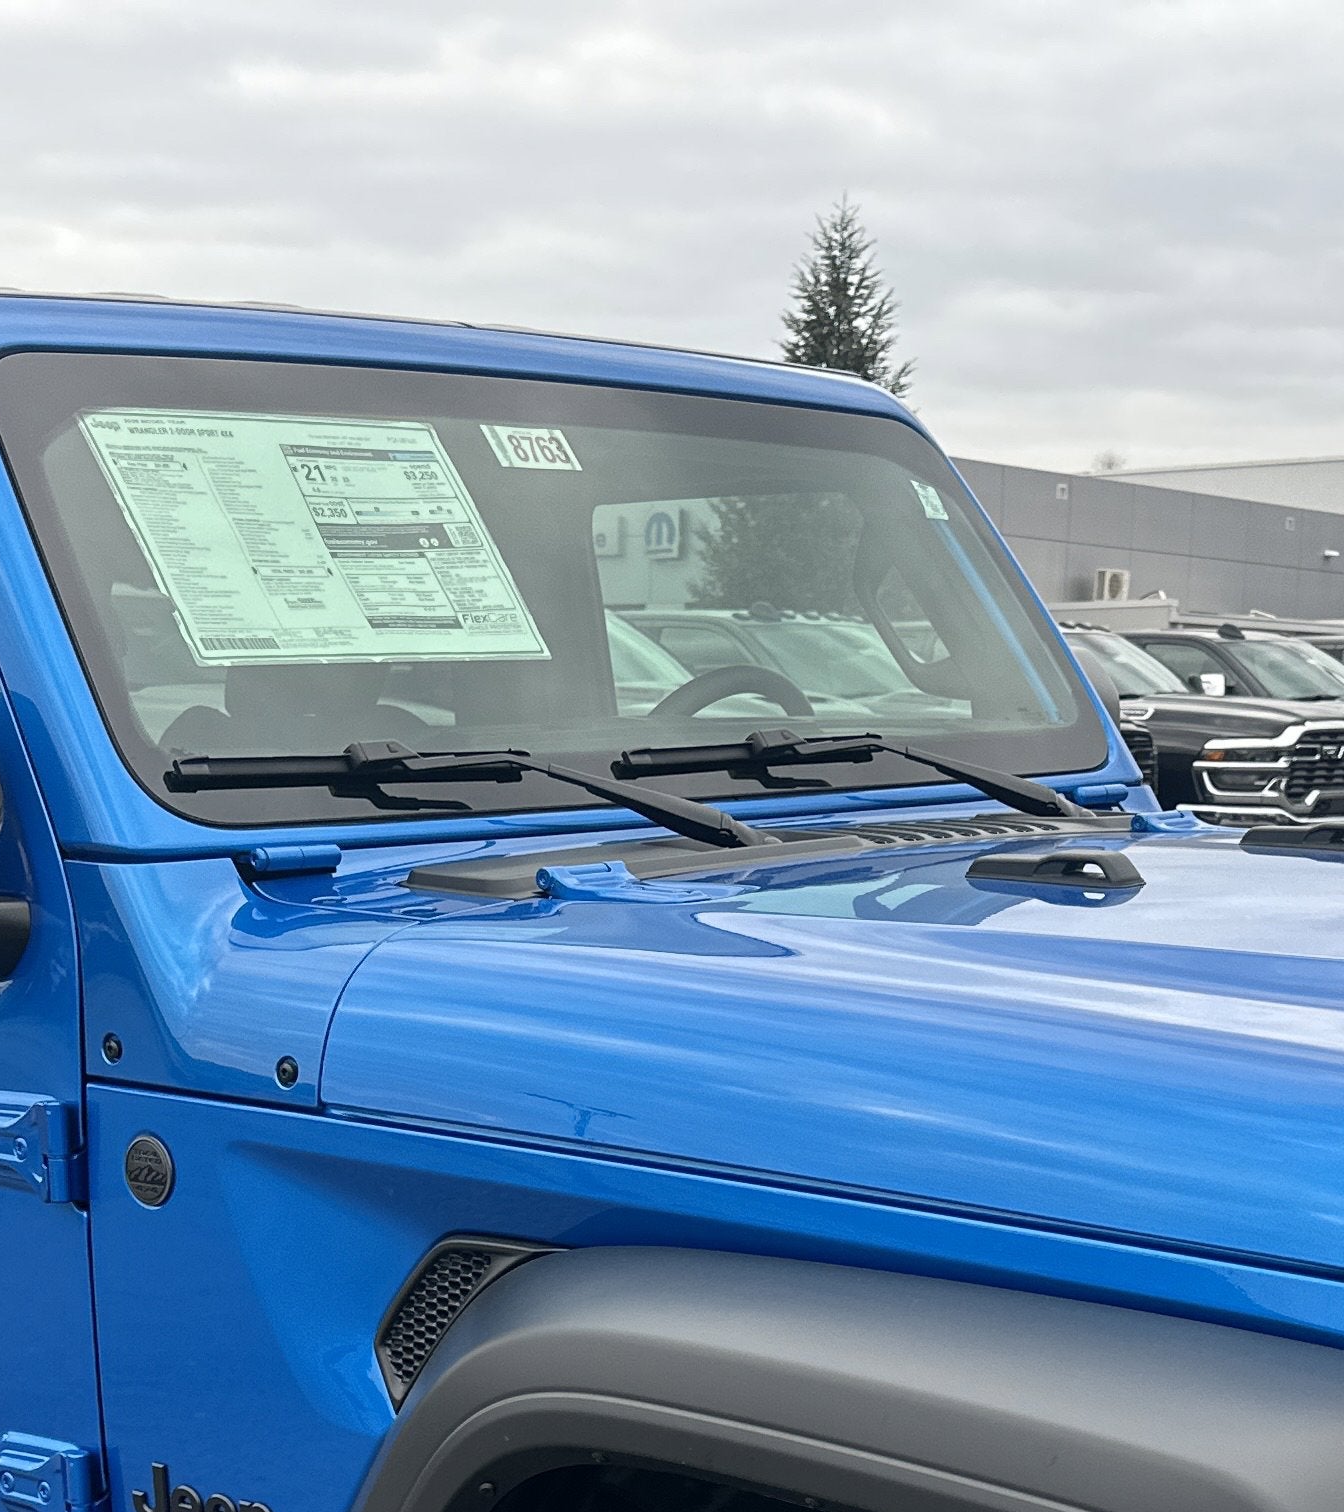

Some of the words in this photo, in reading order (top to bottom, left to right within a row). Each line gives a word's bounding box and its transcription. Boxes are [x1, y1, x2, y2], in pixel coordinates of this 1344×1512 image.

[127, 426, 168, 435] WRANGLER
[507, 434, 571, 464] 8763
[300, 463, 326, 482] 21
[403, 470, 438, 481] $3,250
[312, 506, 347, 518] $2,350
[461, 612, 518, 624] FlexCare
